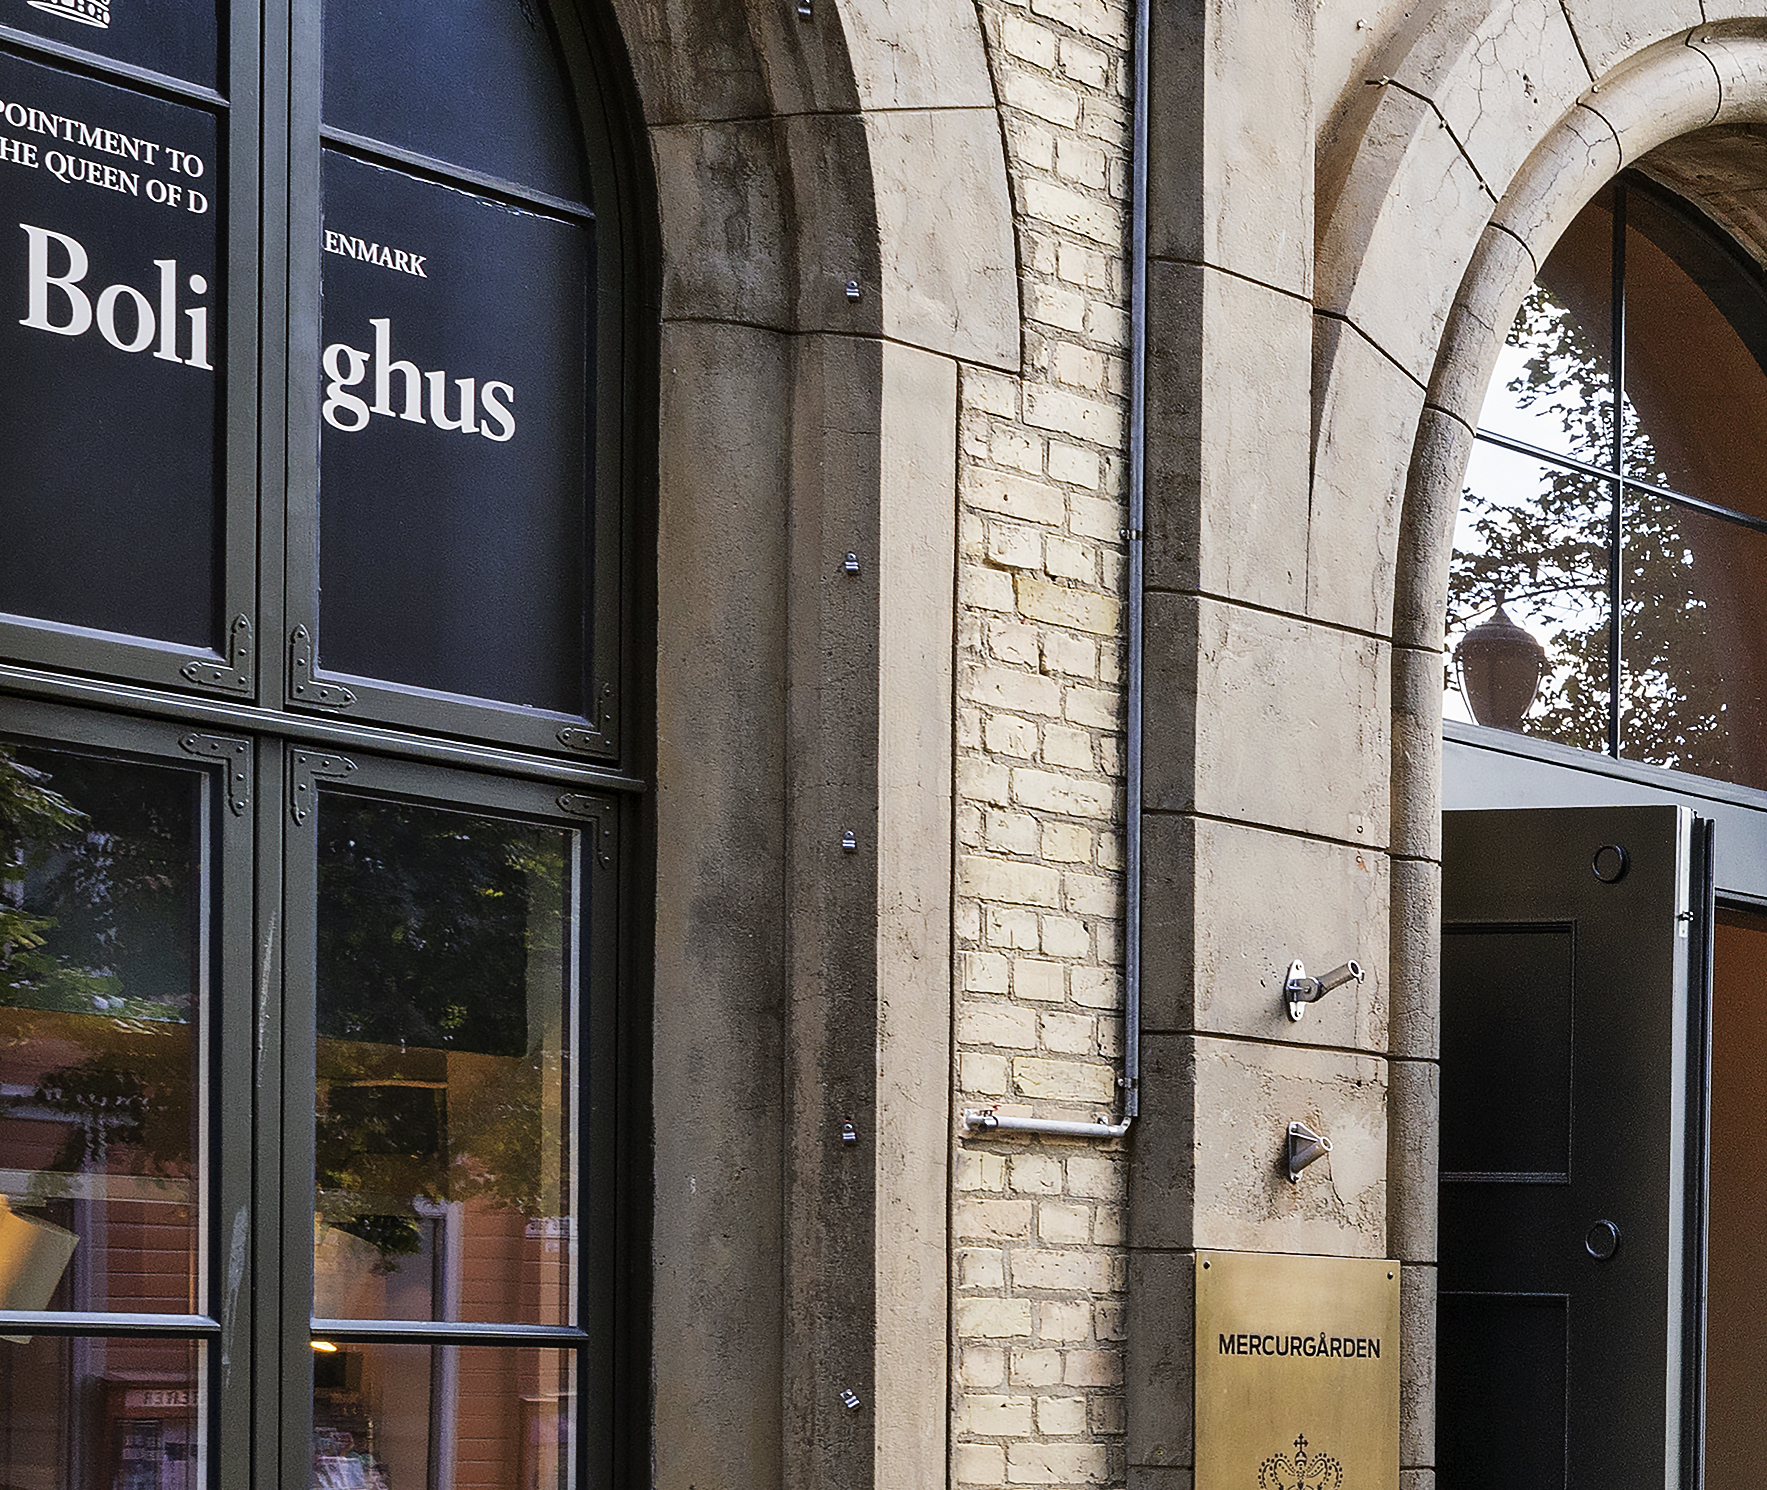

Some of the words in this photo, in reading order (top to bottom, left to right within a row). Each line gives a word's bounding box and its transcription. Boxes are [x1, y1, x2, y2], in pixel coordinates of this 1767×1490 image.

[165, 147, 205, 178] TO
[44, 150, 140, 197] QUEEN
[145, 178, 182, 208] OF
[324, 229, 428, 278] ENMARK
[19, 223, 214, 371] Boli
[322, 318, 516, 442] ghus
[1219, 1331, 1381, 1359] MERCURGÅRDEN
